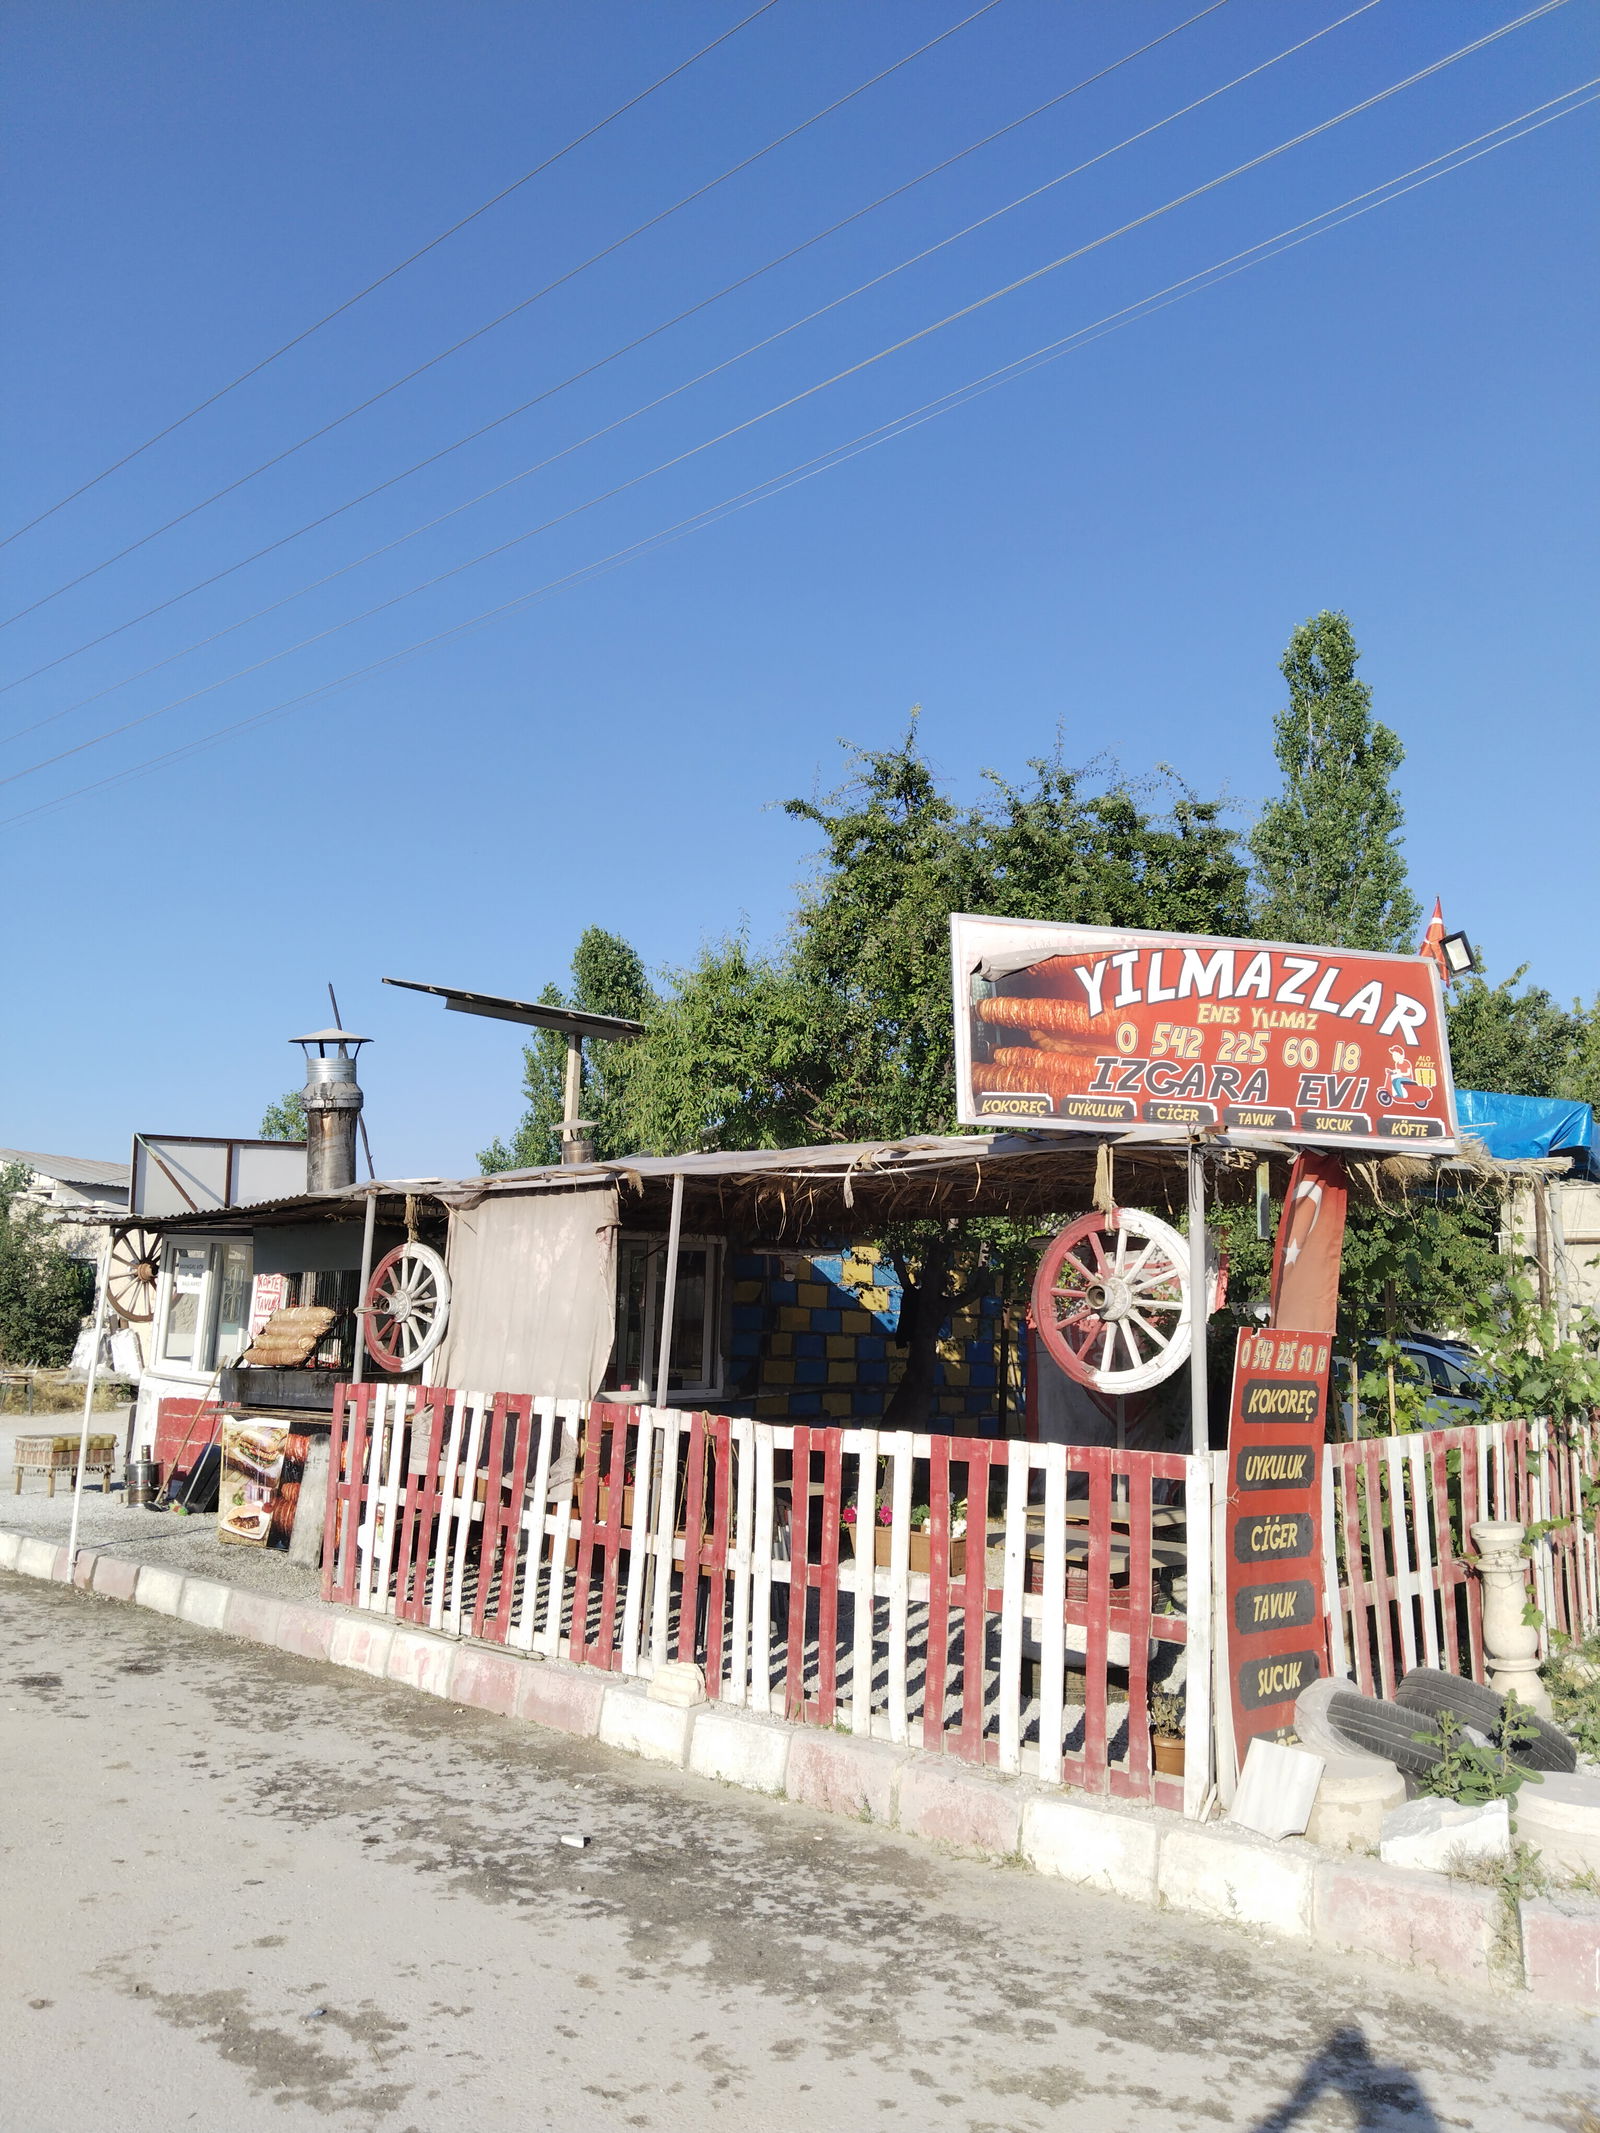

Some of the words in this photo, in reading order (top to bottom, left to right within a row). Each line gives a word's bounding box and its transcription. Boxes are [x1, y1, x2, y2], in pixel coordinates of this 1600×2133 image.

[1073, 949, 1427, 1046] YILMAZLAR
[1197, 1003, 1241, 1024] ENES
[1116, 1022, 1138, 1055] 0
[1151, 1023, 1204, 1059] 542
[1216, 1030, 1271, 1065] 225
[1282, 1037, 1320, 1069] 60
[1332, 1041, 1361, 1073] 18
[1089, 1056, 1269, 1103] IZGARA
[981, 1100, 1048, 1117] KOKOREÇ
[1069, 1102, 1126, 1118] UYKULUK
[1238, 1112, 1277, 1127] TAVUK
[1316, 1117, 1354, 1132] SUCUK
[1391, 1119, 1429, 1137] KÖFTE
[1240, 1339, 1252, 1369] 0
[1251, 1337, 1275, 1370] 542
[1275, 1341, 1299, 1372] 225
[1298, 1344, 1314, 1373] 60
[1314, 1345, 1329, 1375] 18
[1247, 1389, 1317, 1421] KOKOREÇ
[1245, 1454, 1307, 1481] UYKULUK
[1253, 1591, 1297, 1622] TAVUK
[1258, 1661, 1302, 1697] SUCUK
